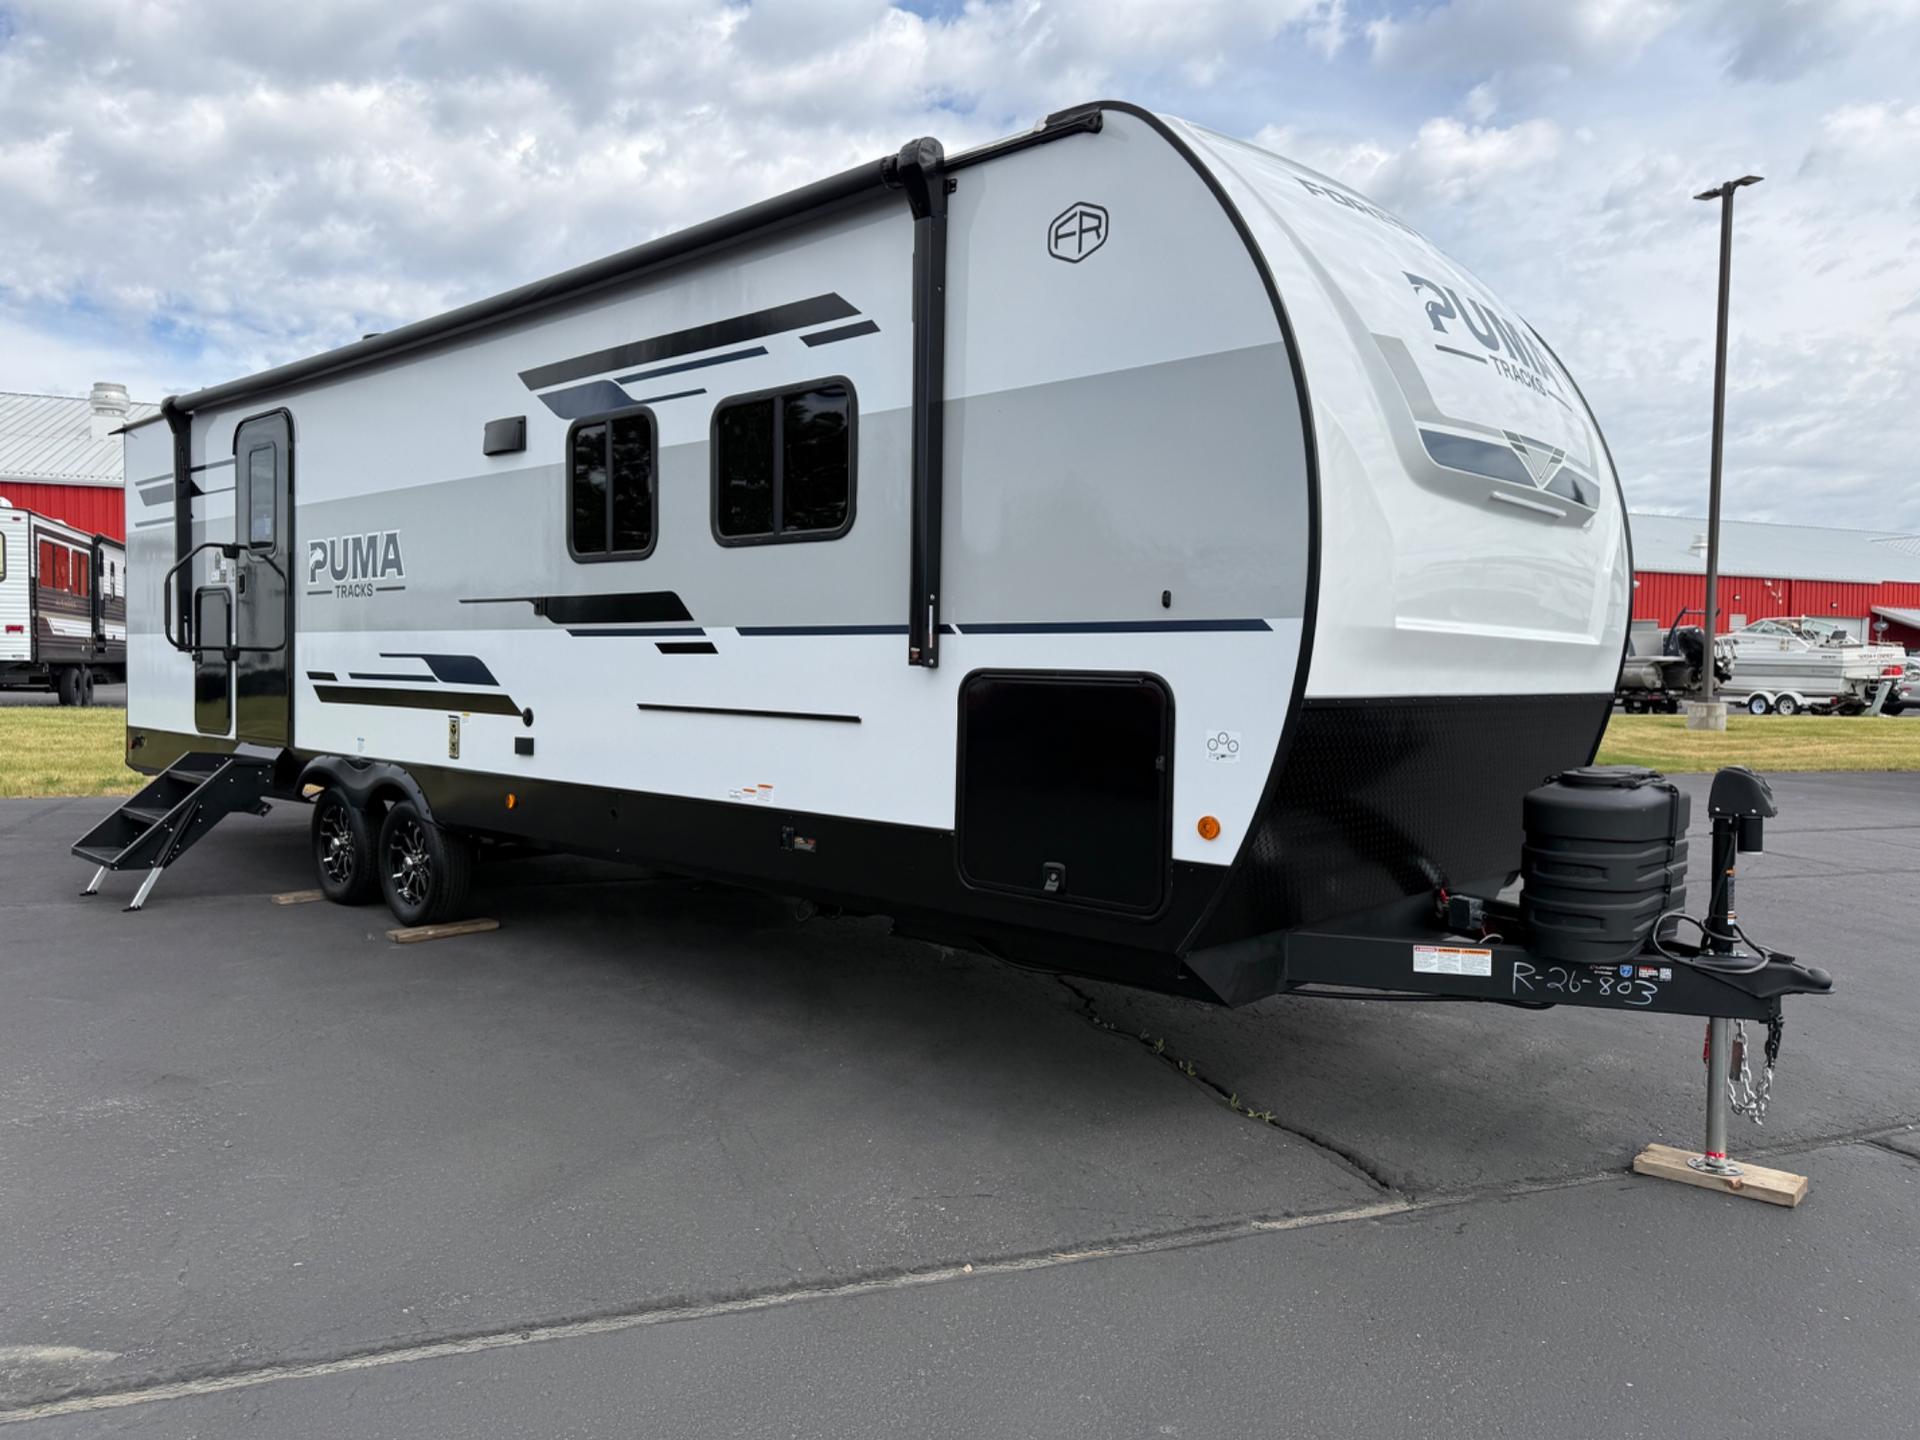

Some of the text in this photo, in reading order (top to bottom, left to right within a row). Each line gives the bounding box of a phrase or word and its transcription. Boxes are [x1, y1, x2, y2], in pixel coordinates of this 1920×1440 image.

[1053, 210, 1102, 254] FR
[1401, 270, 1564, 394] PUMA
[1488, 354, 1547, 396] TRACKS
[307, 529, 405, 585] PUMA
[335, 583, 374, 598] TRACKS
[1512, 962, 1659, 1006] R-26-803
